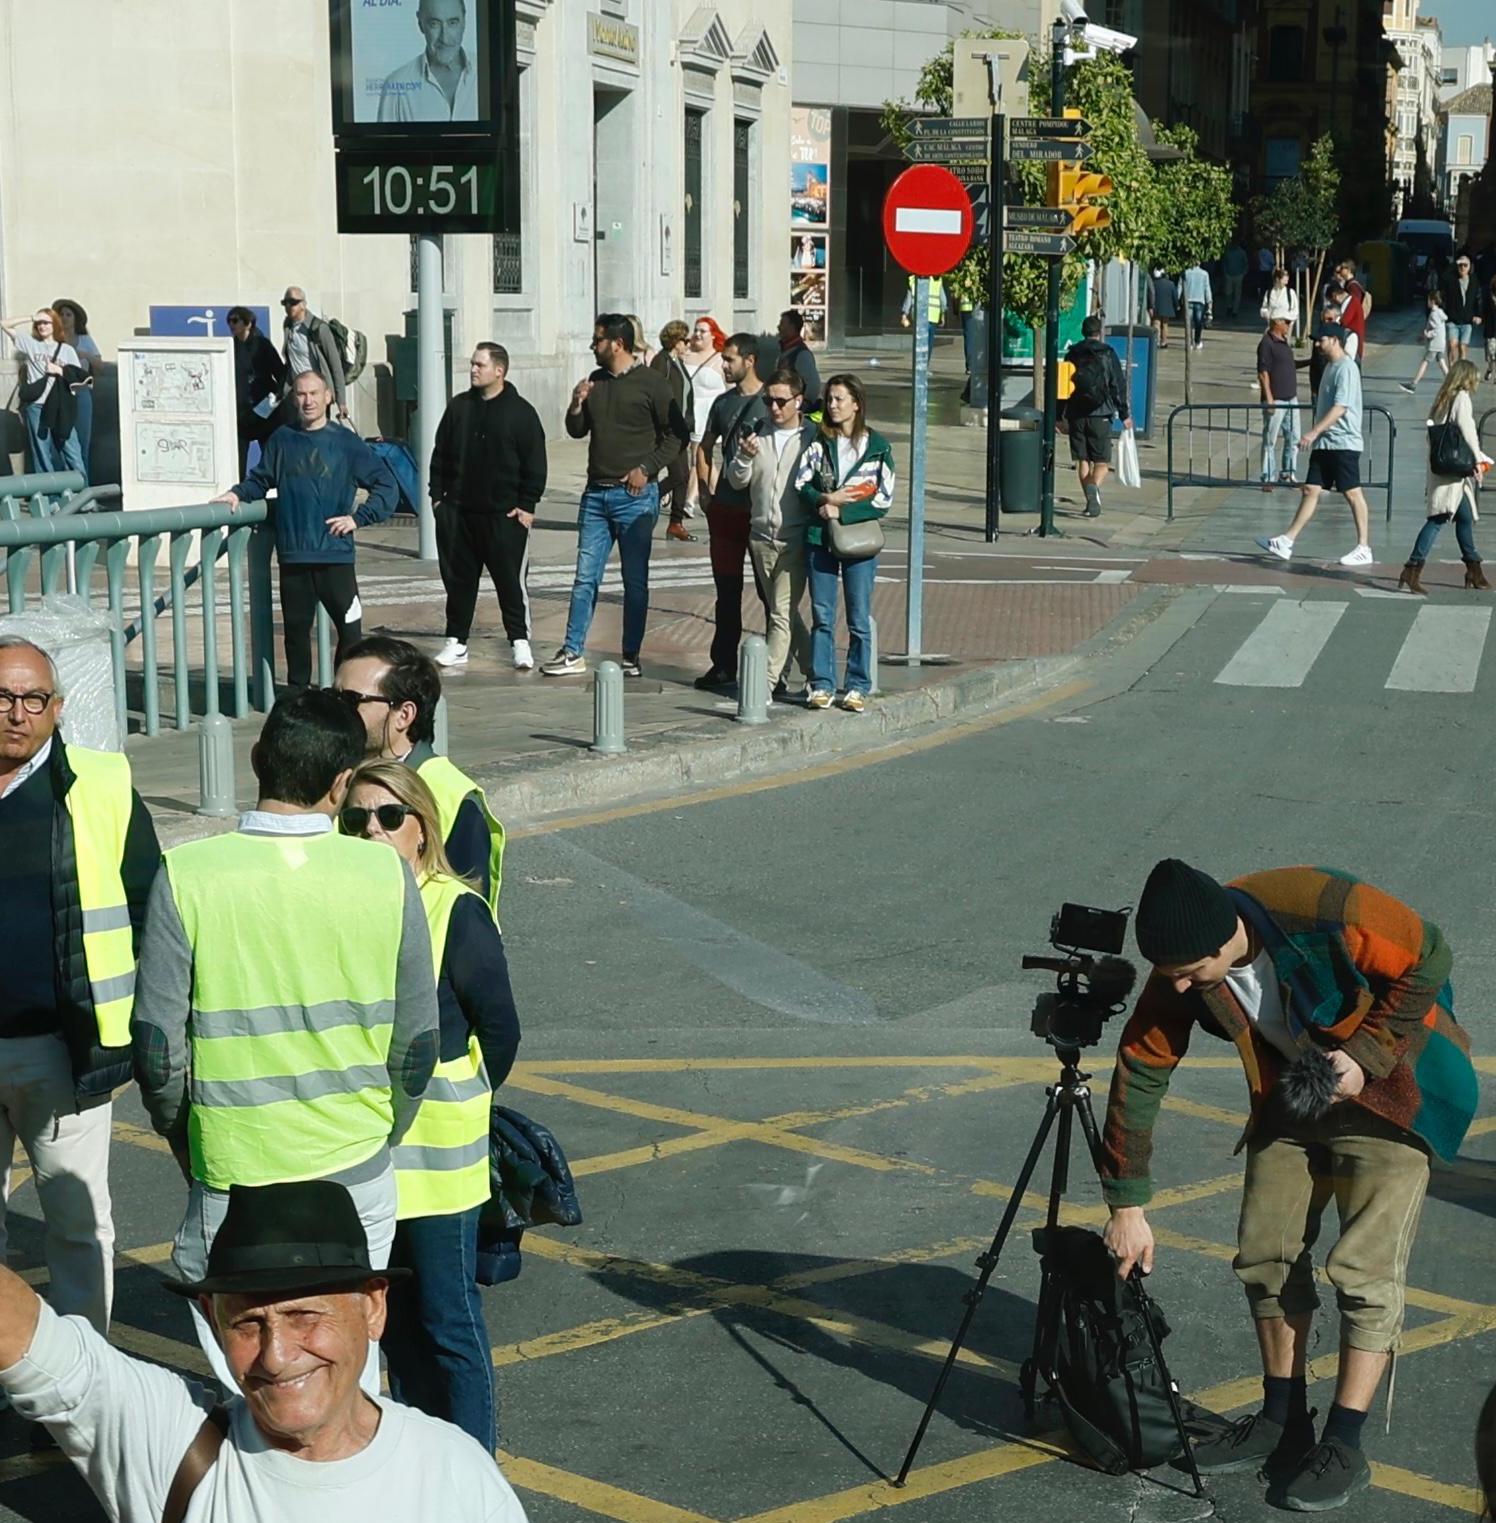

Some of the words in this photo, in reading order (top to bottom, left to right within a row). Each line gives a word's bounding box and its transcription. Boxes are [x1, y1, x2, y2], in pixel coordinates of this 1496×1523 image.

[1012, 150, 1024, 158] DEL
[1030, 150, 1062, 159] MIRADOR
[363, 165, 478, 215] 10:51
